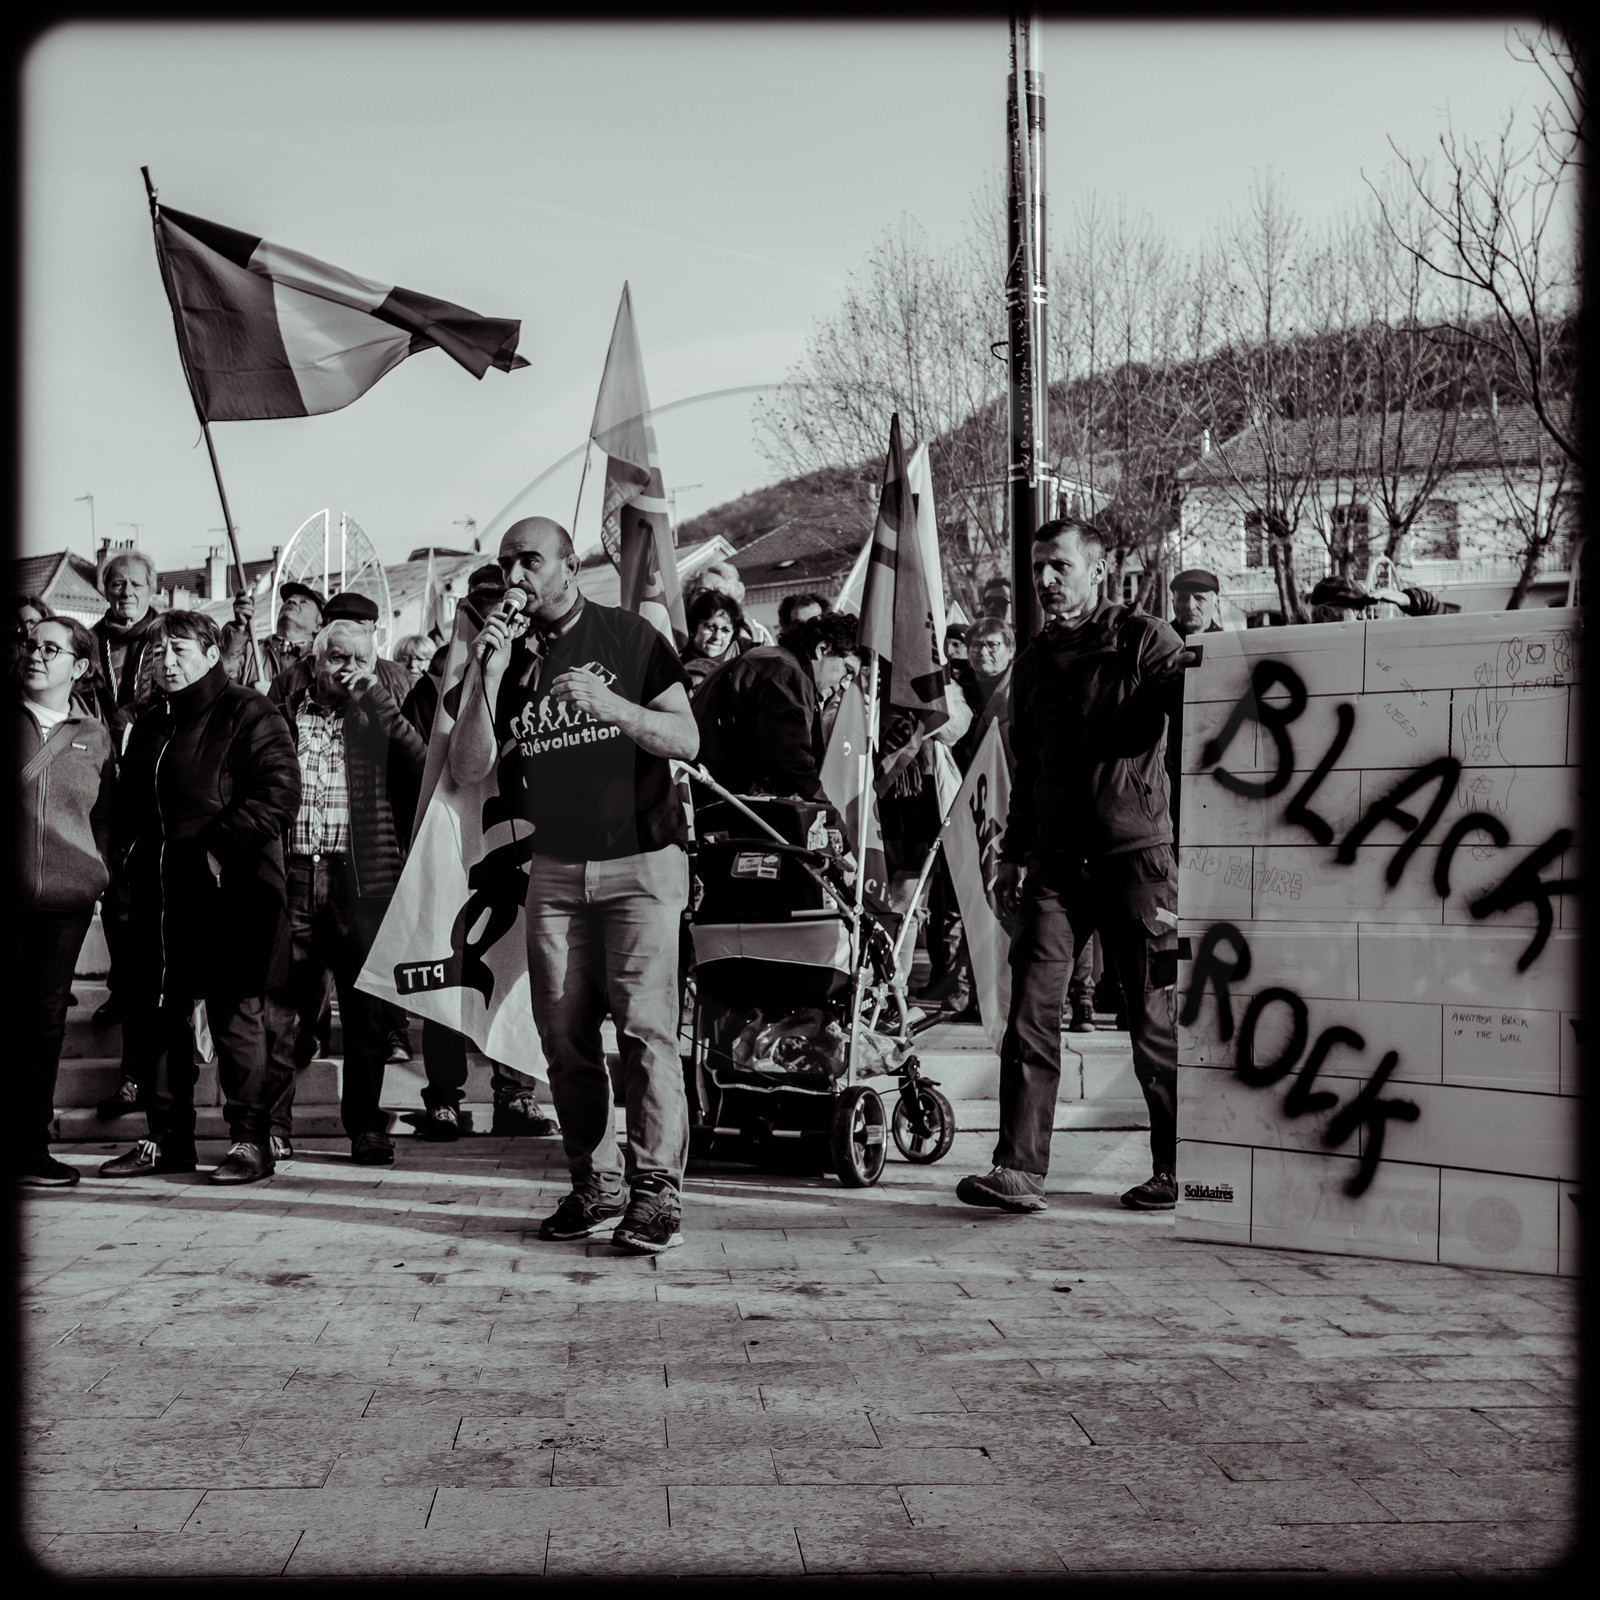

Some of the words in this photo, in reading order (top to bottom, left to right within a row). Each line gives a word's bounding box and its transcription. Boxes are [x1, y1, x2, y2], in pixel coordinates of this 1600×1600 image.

[1511, 674, 1566, 697] TERRE
[1383, 703, 1417, 737] NEED
[1199, 659, 1580, 974] BLACK
[1183, 848, 1221, 876] NO
[1224, 856, 1303, 901] FUTURE
[1452, 1012, 1493, 1025] ANOTHER
[1476, 1030, 1493, 1039] THE
[1500, 1033, 1522, 1043] WALL
[1178, 921, 1421, 1198] ROCK
[1184, 1184, 1234, 1200] Solidaires
